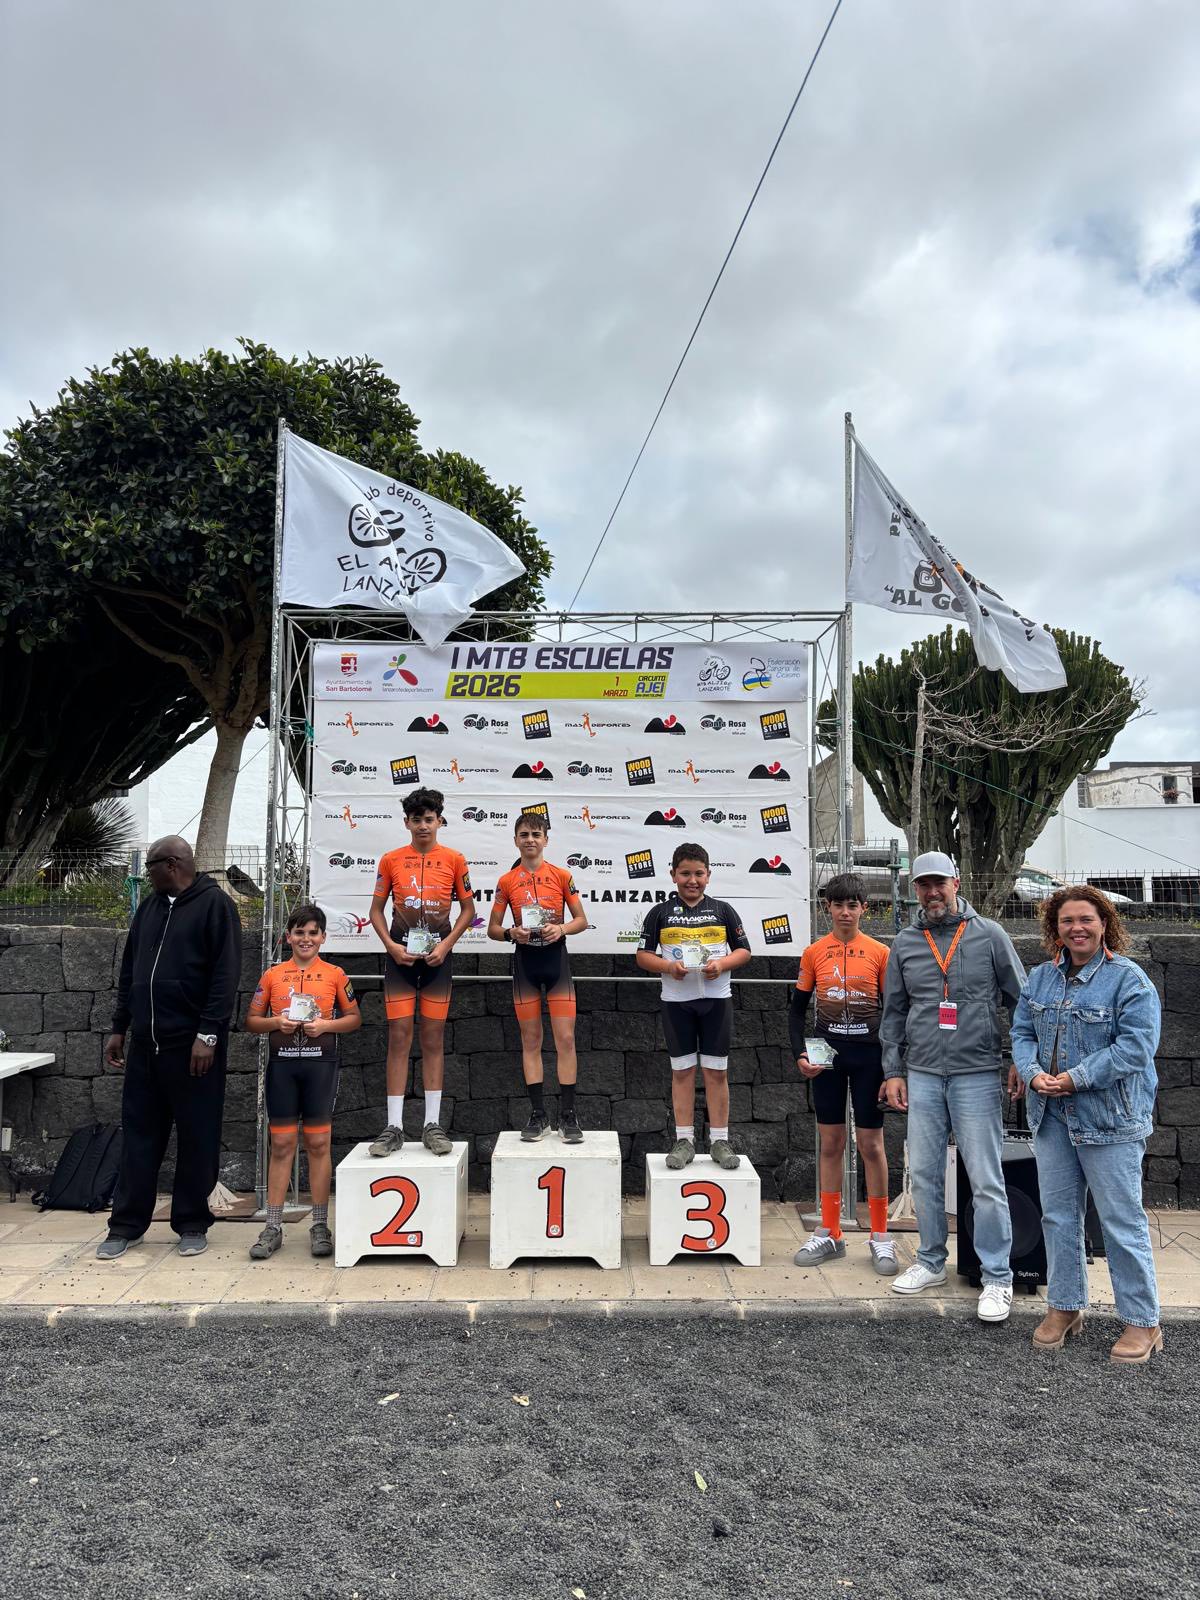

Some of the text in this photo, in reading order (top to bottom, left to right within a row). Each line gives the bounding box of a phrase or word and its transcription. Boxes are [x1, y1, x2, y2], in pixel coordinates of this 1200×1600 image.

[386, 482, 436, 542] deportivo
[337, 554, 369, 572] EL
[450, 646, 674, 670] I MTB ESCUELAS
[450, 674, 522, 697] 2026
[615, 676, 620, 686] 1
[636, 682, 664, 693] AJEI
[491, 719, 509, 727] Rosa
[524, 712, 547, 725] WOOD
[729, 720, 746, 728] Rosa
[762, 712, 785, 725] WOOD
[525, 721, 549, 732] STORE
[763, 722, 788, 734] STORE
[392, 758, 415, 770] WOOD
[628, 759, 650, 772] WOOD
[393, 767, 417, 778] STORE
[629, 768, 652, 780] STORE
[762, 806, 786, 819] WOOD
[764, 815, 788, 826] STORE
[627, 852, 650, 864] WOOD
[628, 862, 652, 872] STORE
[668, 914, 718, 922] ZAMAKONA
[764, 917, 788, 930] WOOD
[765, 926, 789, 937] STORE
[537, 1165, 566, 1238] 1
[369, 1174, 423, 1247] 2
[680, 1180, 730, 1252] 3
[1017, 1270, 1040, 1278] Sytech
